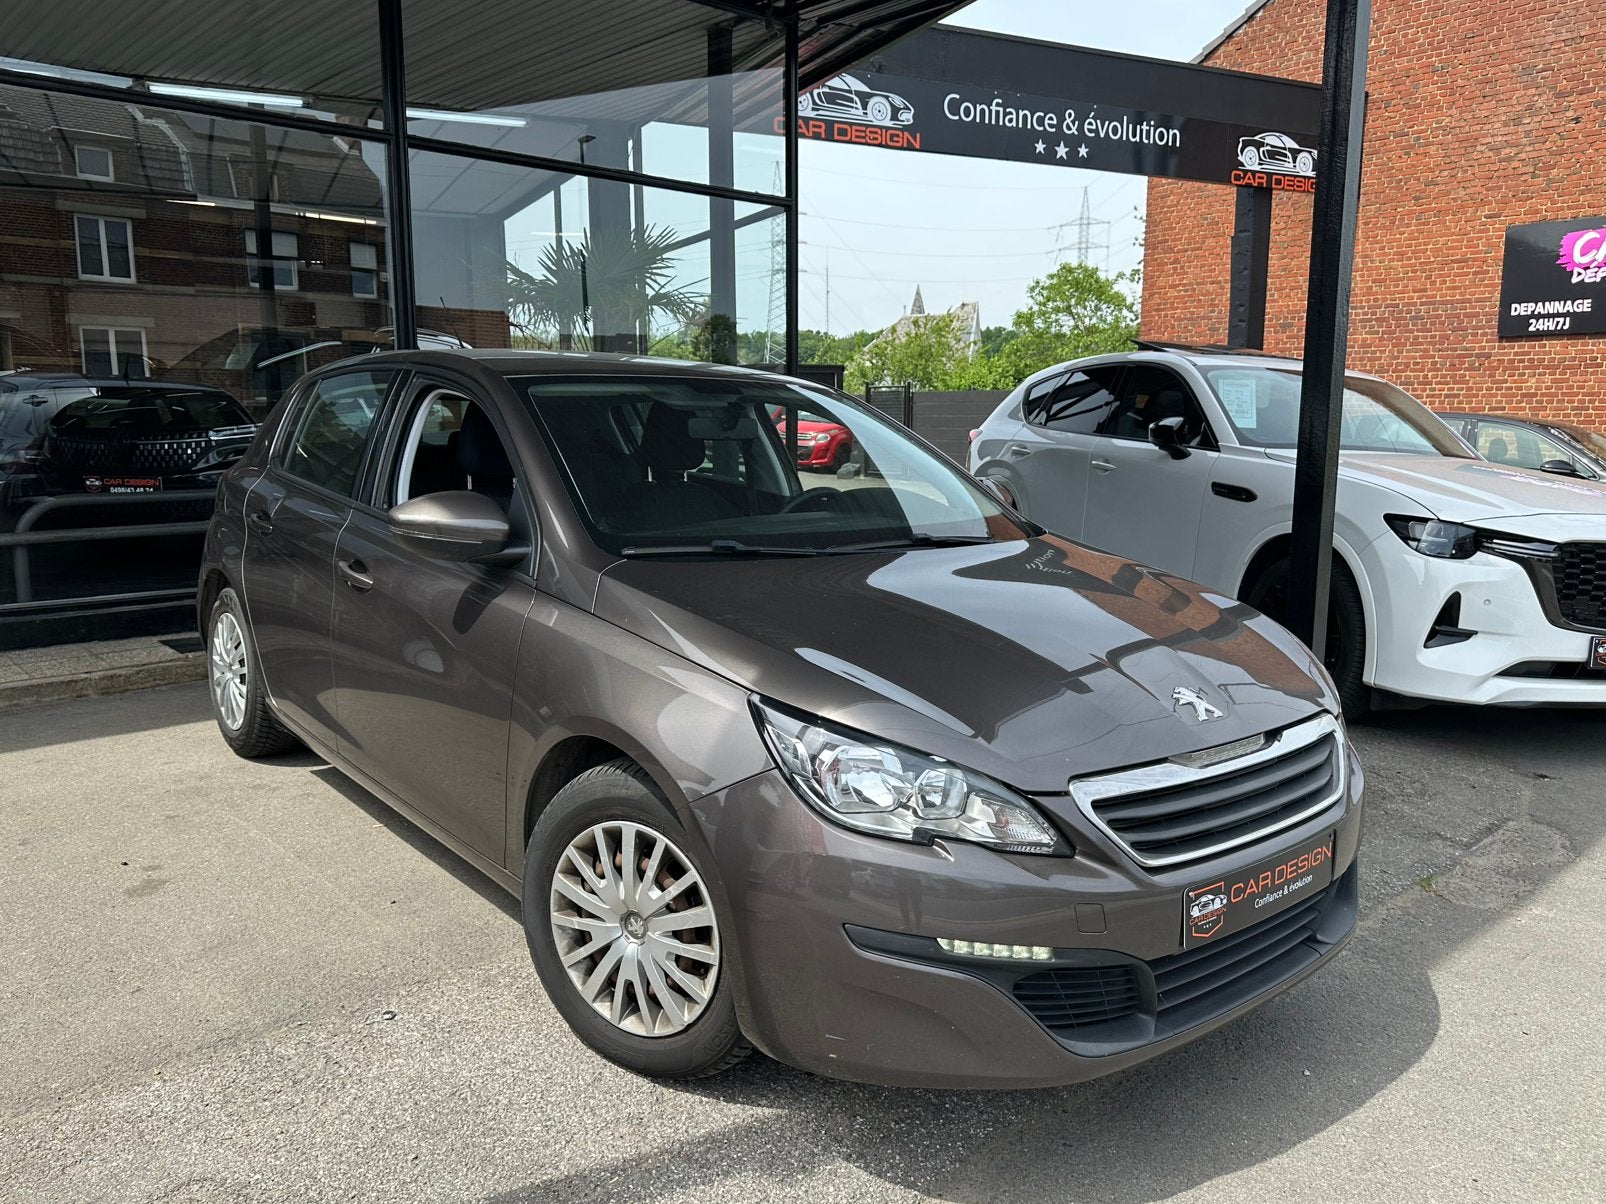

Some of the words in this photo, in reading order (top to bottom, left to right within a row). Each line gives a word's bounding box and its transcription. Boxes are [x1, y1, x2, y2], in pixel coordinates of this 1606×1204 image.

[943, 93, 1057, 132] Confiance
[1062, 109, 1078, 135] &
[1083, 111, 1180, 147] évolution
[833, 123, 922, 149] DESIGN
[1231, 170, 1267, 187] CAR
[1271, 174, 1316, 192] DESIG
[1510, 299, 1592, 316] DEPANNAGE
[1528, 317, 1570, 331] 24H/7J
[1230, 871, 1272, 903] CAR
[1274, 842, 1333, 885] DESIGN
[1254, 890, 1283, 909] Confiance
[1283, 885, 1289, 895] &
[1289, 874, 1313, 892] évolution
